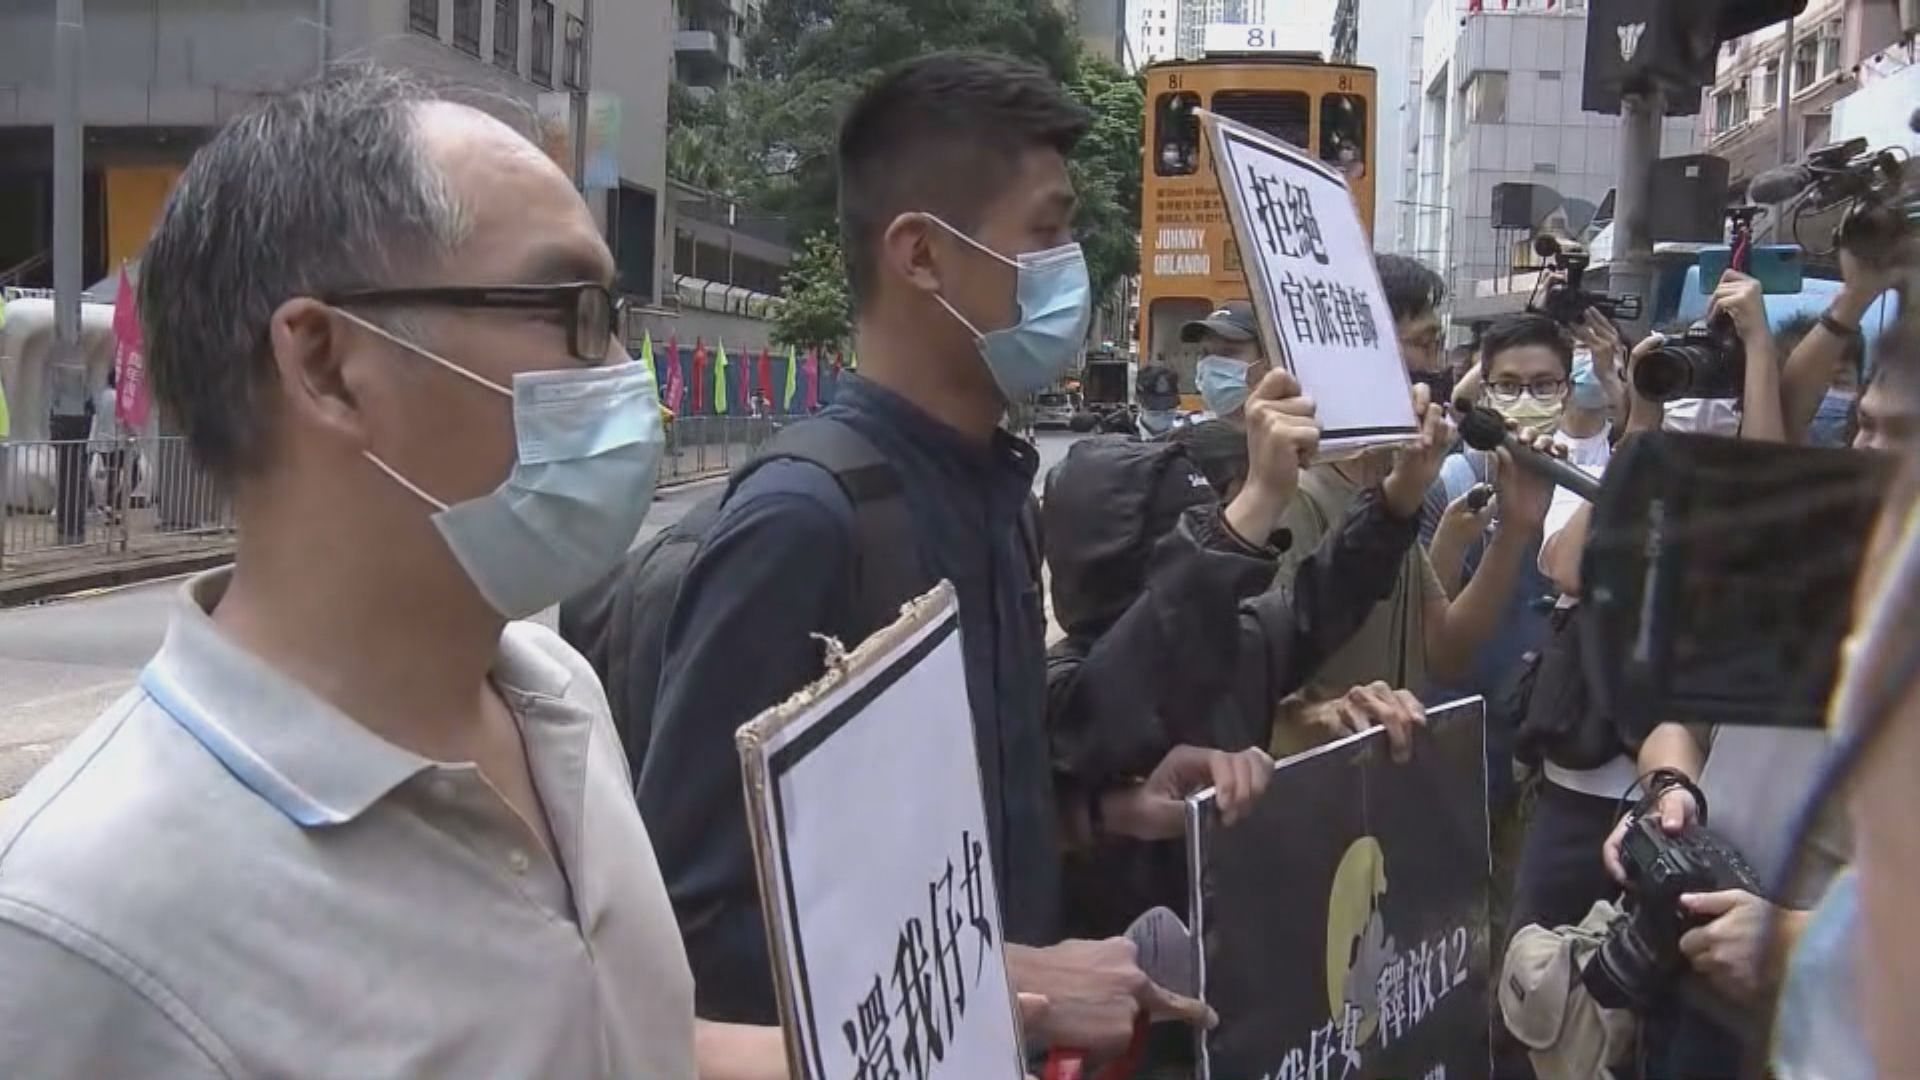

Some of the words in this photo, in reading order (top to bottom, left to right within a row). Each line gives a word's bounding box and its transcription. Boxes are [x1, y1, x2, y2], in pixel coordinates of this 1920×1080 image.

[1247, 28, 1276, 48] 81
[1168, 74, 1183, 89] 81
[1337, 76, 1353, 90] 81
[1247, 164, 1330, 265] 拒絕
[1154, 228, 1206, 250] JOHNNY
[1153, 253, 1211, 275] ORLANDO
[1280, 270, 1379, 349] 官派律師
[1376, 926, 1468, 1049] 釋放12
